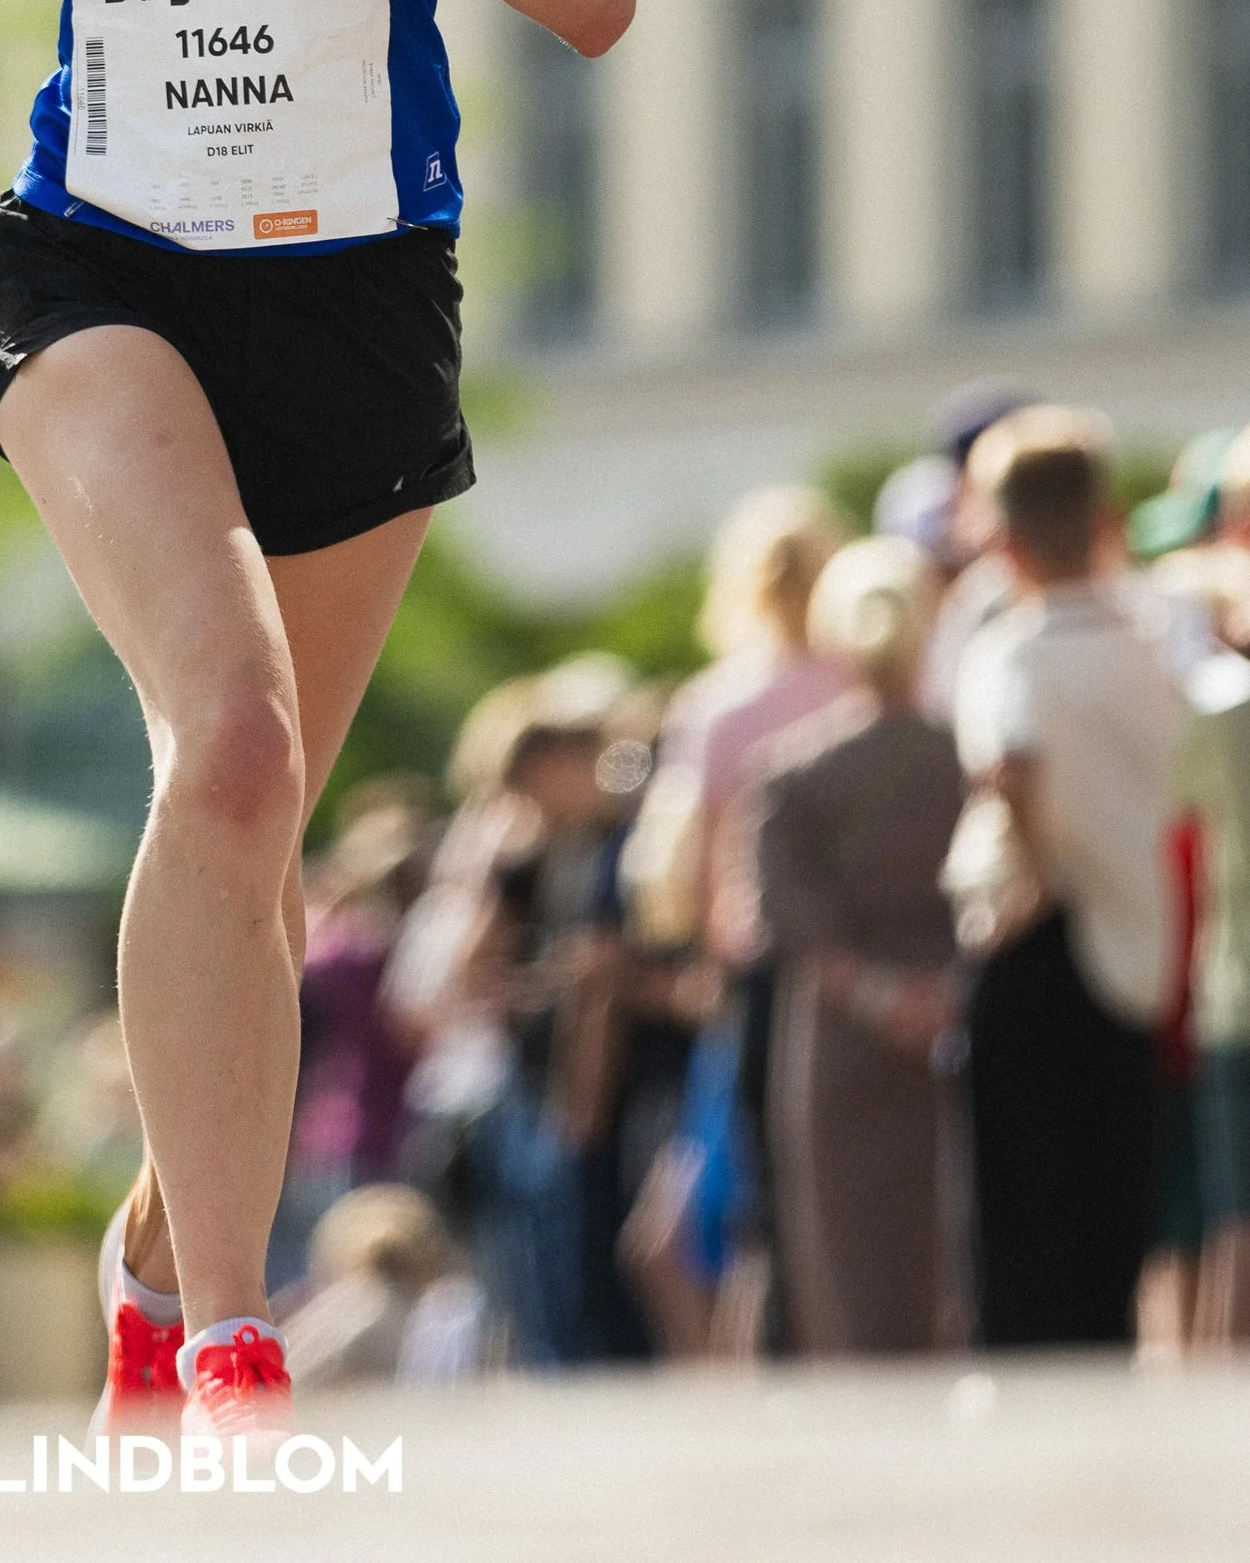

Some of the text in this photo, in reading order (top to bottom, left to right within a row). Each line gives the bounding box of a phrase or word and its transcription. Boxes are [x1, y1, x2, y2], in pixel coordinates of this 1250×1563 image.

[175, 24, 275, 59] 11646
[165, 74, 295, 110] NANNA
[187, 119, 274, 136] LAPUAN VIRKIÄ
[206, 144, 254, 157] D18 ELIT
[150, 219, 235, 234] CHALMERS
